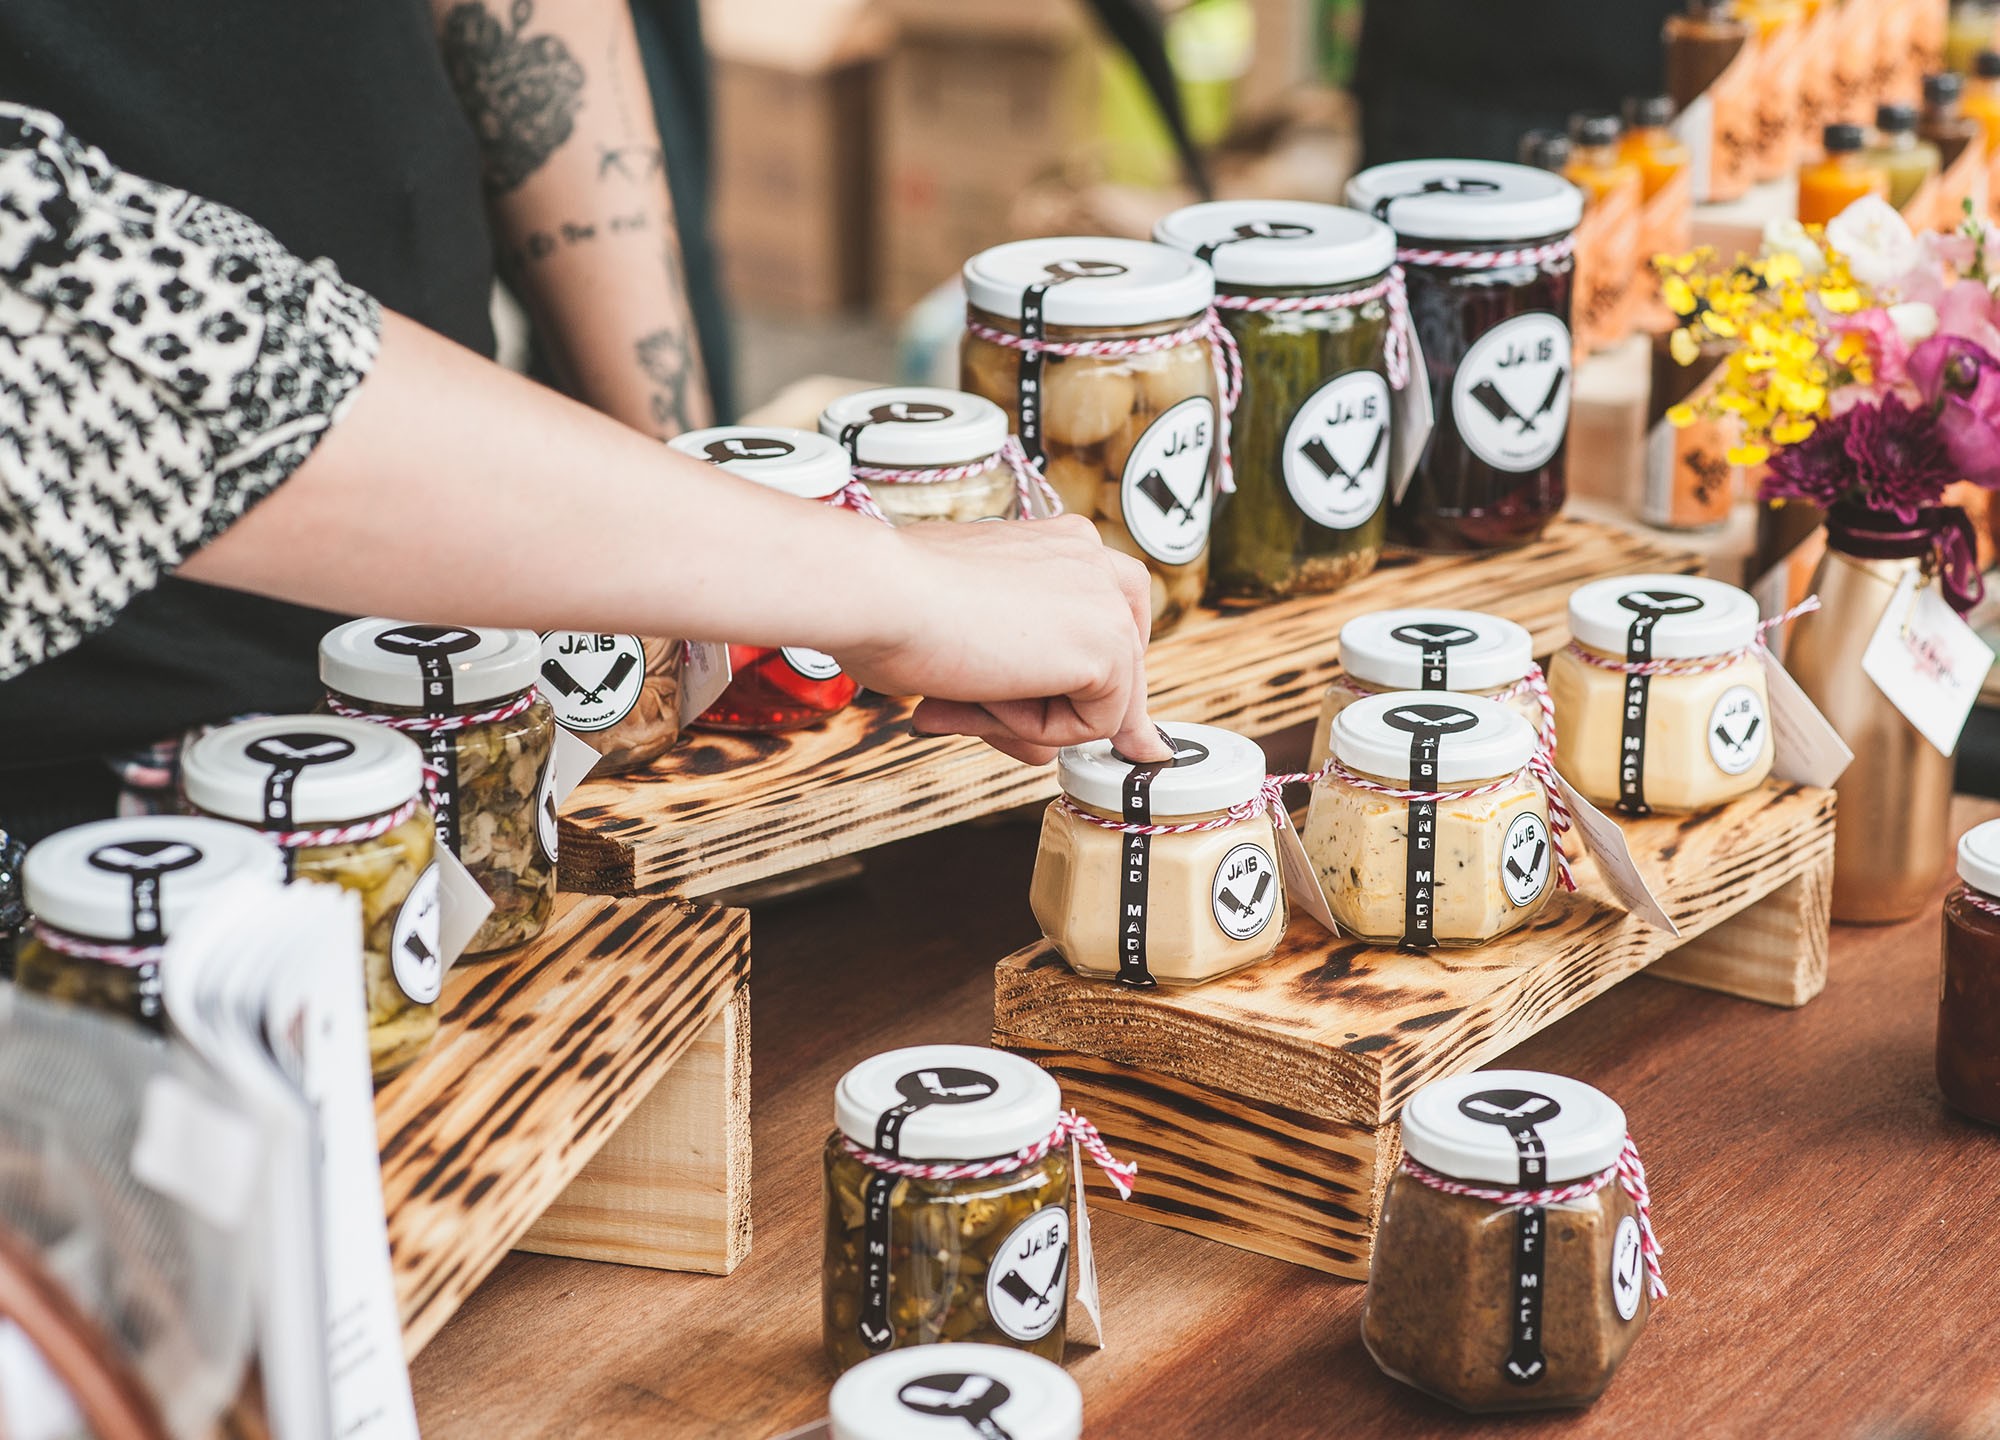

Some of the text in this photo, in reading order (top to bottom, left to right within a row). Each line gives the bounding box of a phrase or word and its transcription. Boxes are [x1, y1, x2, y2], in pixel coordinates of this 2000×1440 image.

[558, 634, 615, 655] JAIS
[566, 710, 616, 723] HAND MADE
[1512, 825, 1535, 849] JAIS
[1227, 856, 1258, 881] JAIS
[1414, 870, 1432, 930] MADE
[1126, 904, 1143, 965] MADE
[1019, 1224, 1059, 1260] JAIS
